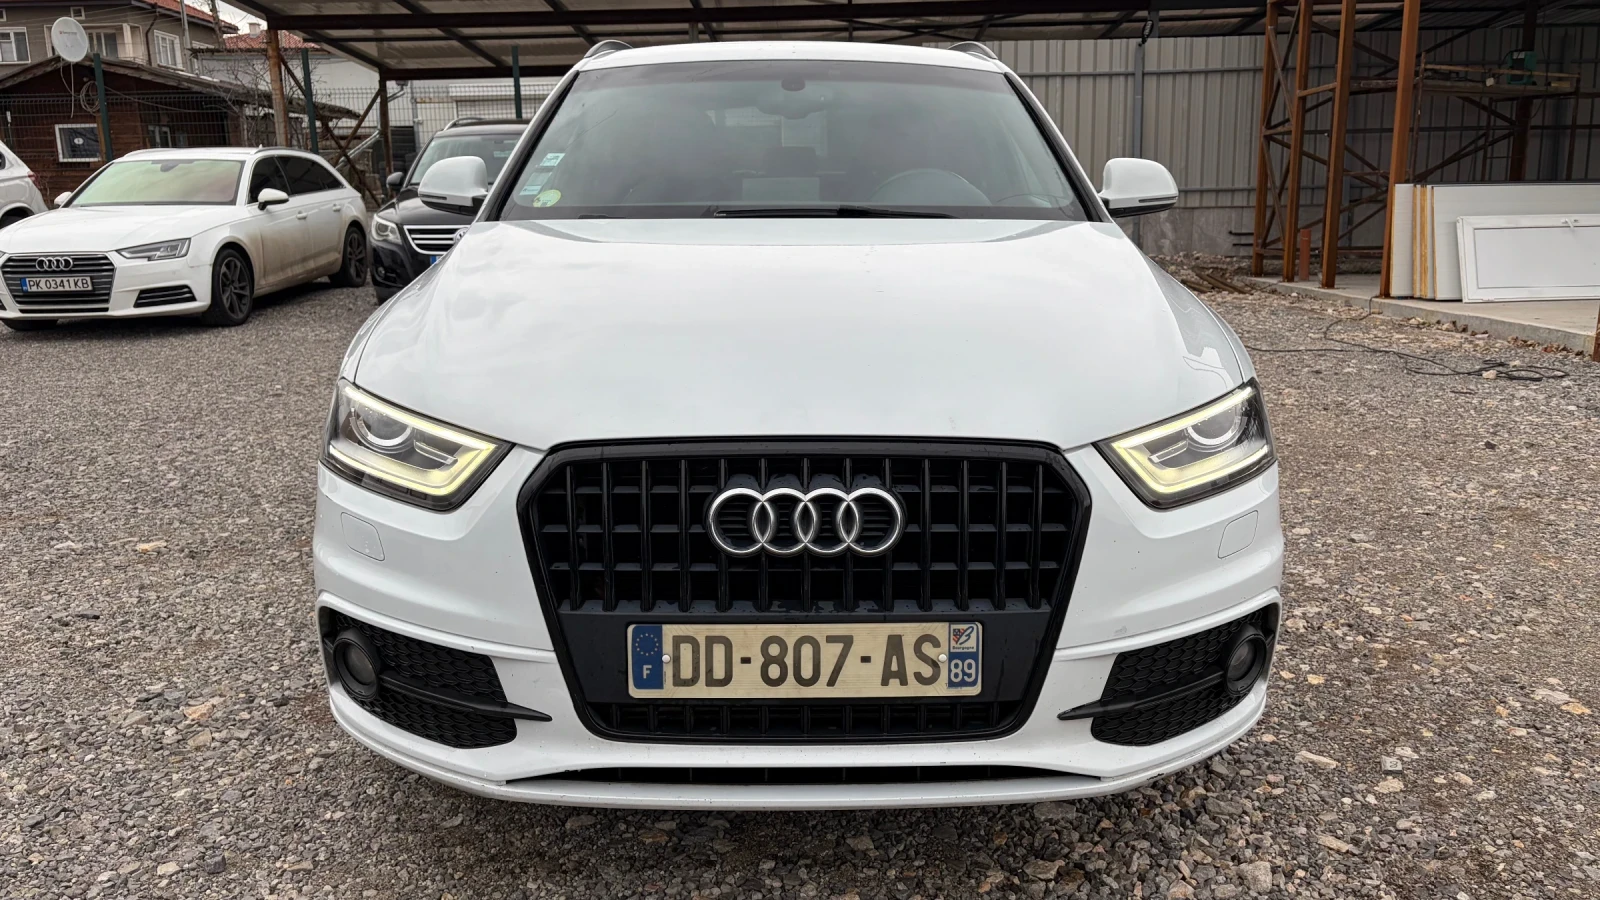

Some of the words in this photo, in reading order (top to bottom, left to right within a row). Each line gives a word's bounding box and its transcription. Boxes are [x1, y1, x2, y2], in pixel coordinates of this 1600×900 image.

[28, 280, 43, 290] PK
[45, 279, 72, 289] 0341
[74, 278, 90, 288] KB
[672, 634, 942, 687] DD-807-AS
[642, 664, 653, 679] F
[950, 659, 976, 683] 89
